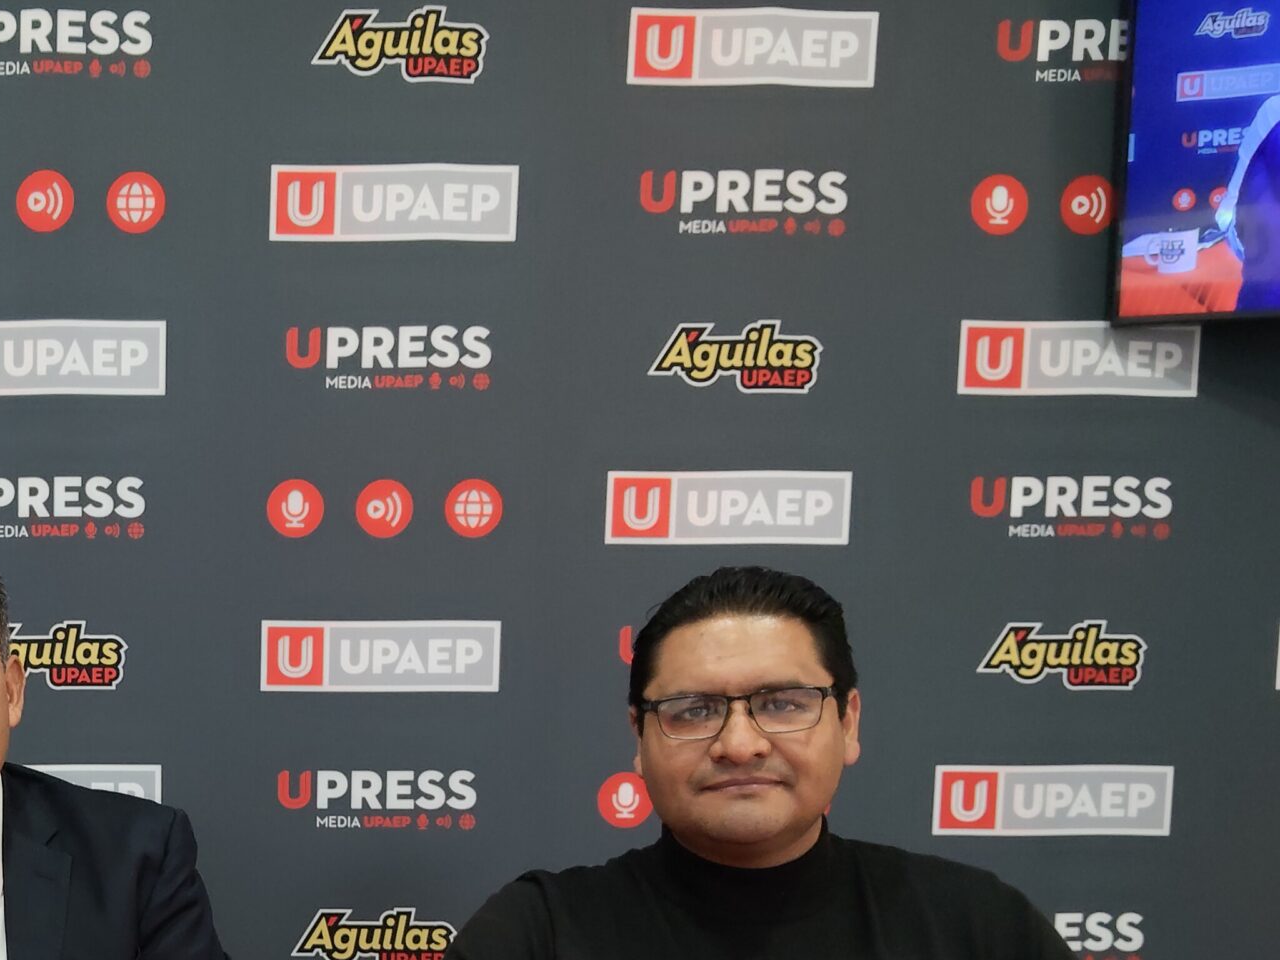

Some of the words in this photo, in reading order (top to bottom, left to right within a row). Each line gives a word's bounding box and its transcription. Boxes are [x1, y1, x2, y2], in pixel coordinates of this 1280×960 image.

[325, 13, 479, 69] Águilas
[646, 25, 684, 70] U
[711, 28, 858, 67] UPAEP
[996, 18, 1129, 62] UPRE
[33, 60, 83, 75] UPAEP
[408, 57, 477, 75] UPAEP
[1036, 69, 1081, 82] MEDIA
[288, 181, 324, 226] U
[353, 184, 500, 222] UPAEP
[640, 169, 847, 214] UPRESS
[679, 219, 726, 234] MEDIA
[4, 339, 148, 376] UPAEP
[285, 325, 492, 370] UPRESS
[661, 327, 813, 379] Águilas
[976, 336, 1013, 380] U
[1039, 339, 1182, 378] UPAEP
[326, 375, 371, 389] MEDIA
[375, 374, 424, 388] UPAEP
[743, 369, 811, 386] UPAEP
[623, 487, 660, 530] U
[688, 490, 832, 526] UPAEP
[971, 476, 1173, 519] UPRESS
[31, 524, 79, 538] UPAEP
[1008, 524, 1055, 538] MEDIA
[278, 636, 313, 678] U
[341, 639, 482, 674] UPAEP
[990, 627, 1138, 677] Águilas
[52, 667, 117, 684] UPAEP
[1070, 667, 1135, 684] UPAEP
[277, 770, 476, 810] UPRESS
[951, 780, 987, 822] U
[1013, 783, 1155, 818] UPAEP
[316, 816, 360, 829] MEDIA
[364, 816, 411, 829] UPAEP
[304, 914, 448, 960] Águilas
[1054, 912, 1144, 951] ESS
